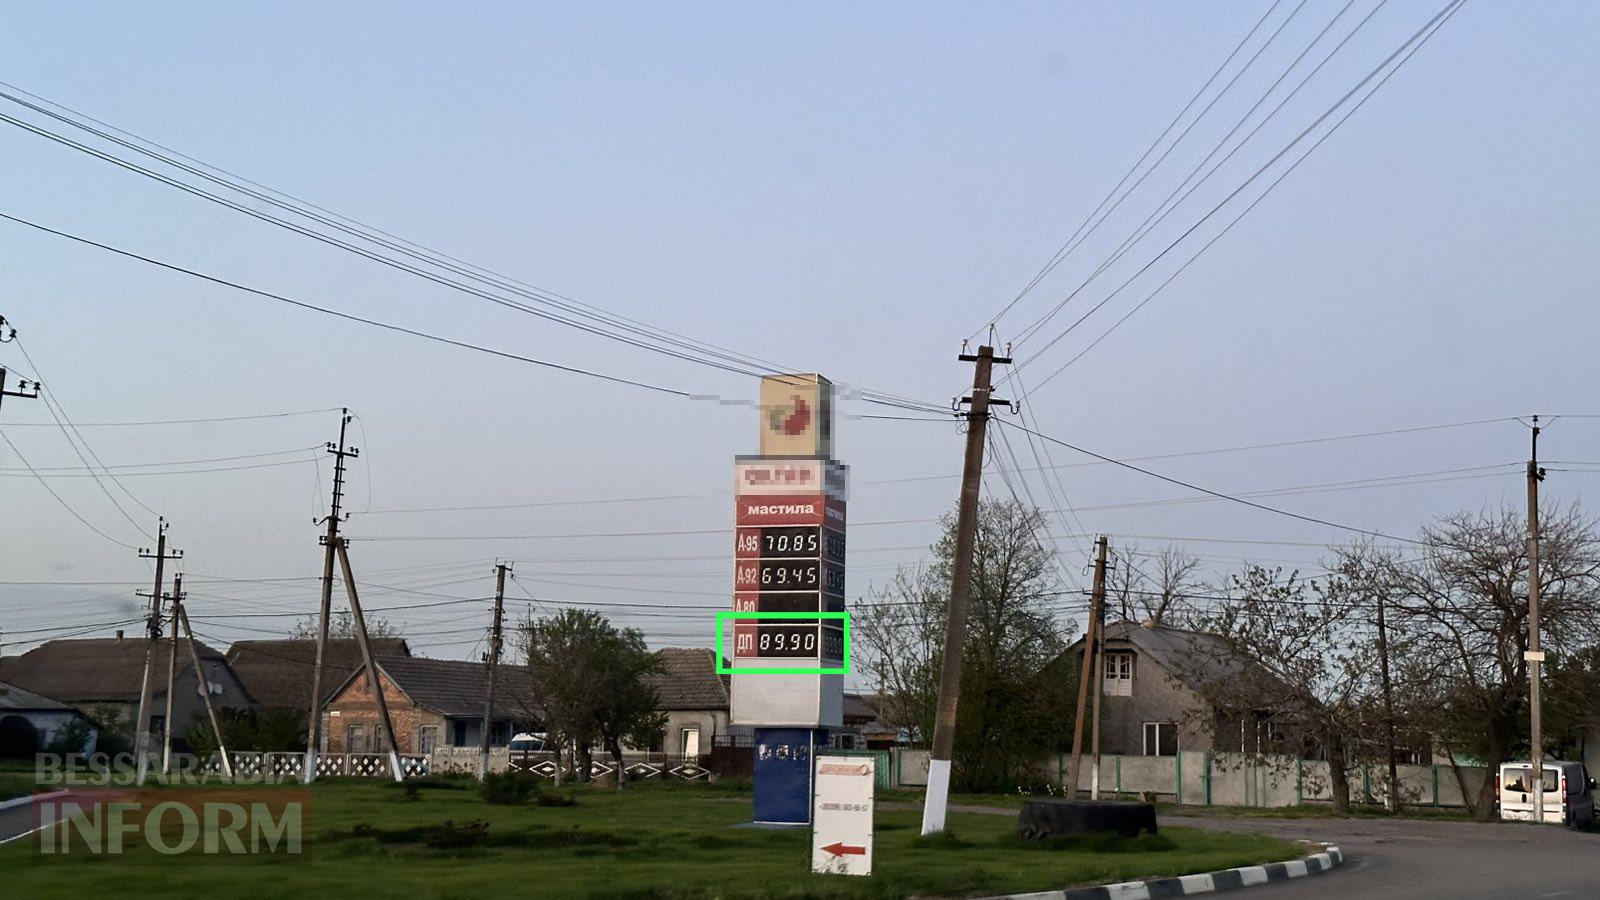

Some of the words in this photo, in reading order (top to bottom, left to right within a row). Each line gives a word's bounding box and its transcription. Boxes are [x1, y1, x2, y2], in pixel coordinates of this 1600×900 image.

[748, 504, 814, 515] мастила
[765, 534, 817, 552] 70.85
[762, 567, 816, 584] 69.45
[737, 633, 753, 653] ДП
[760, 633, 815, 651] 89.90
